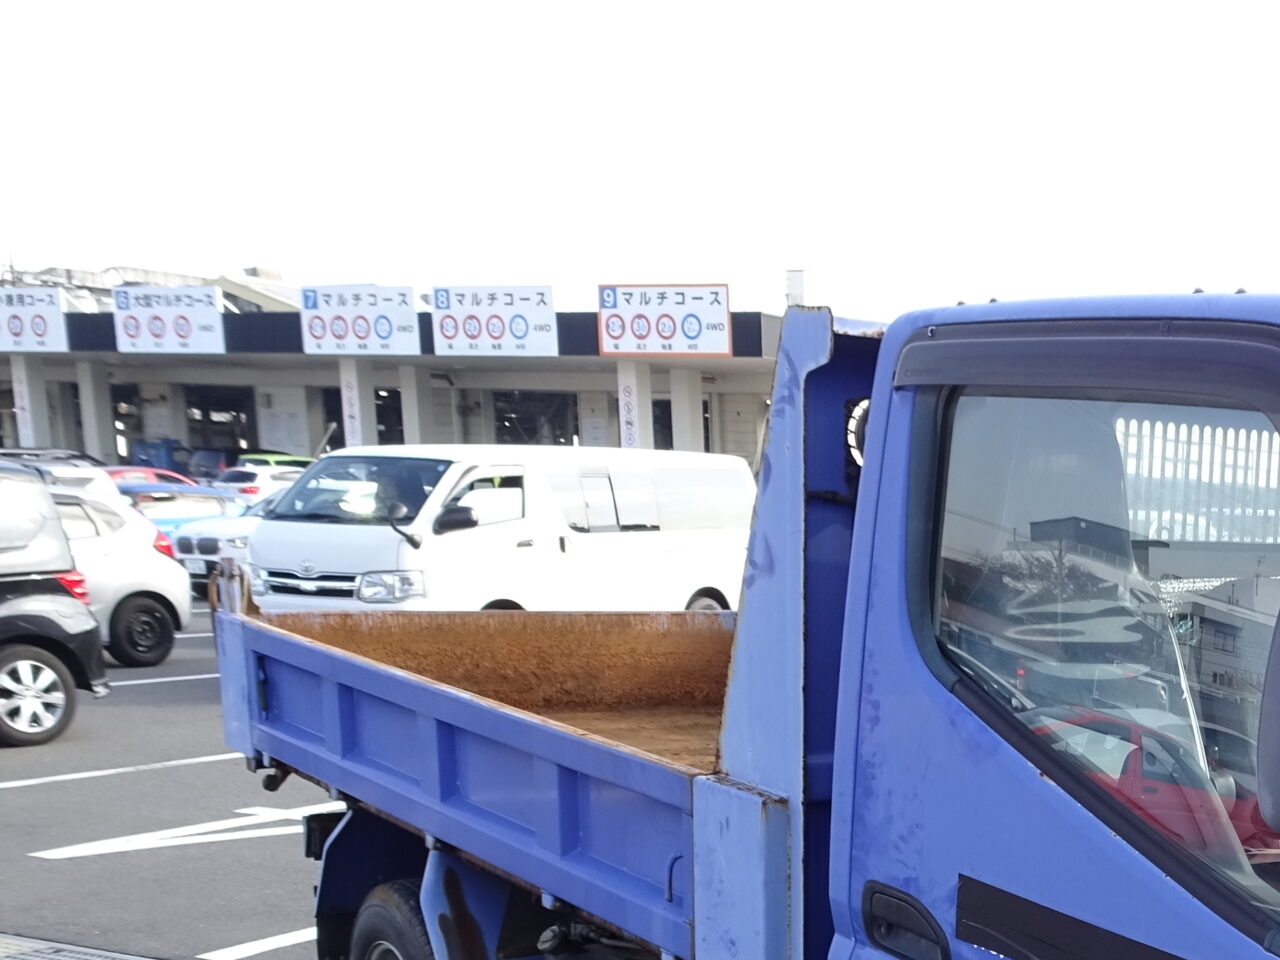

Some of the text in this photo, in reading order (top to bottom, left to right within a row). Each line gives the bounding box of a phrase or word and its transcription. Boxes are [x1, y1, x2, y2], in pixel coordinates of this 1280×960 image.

[304, 290, 409, 309] 7 マルチコース
[437, 290, 547, 308] 8 マルチコース
[603, 289, 722, 307] 9 マルチコース
[533, 323, 551, 333] 4WD
[705, 322, 725, 332] 4WD
